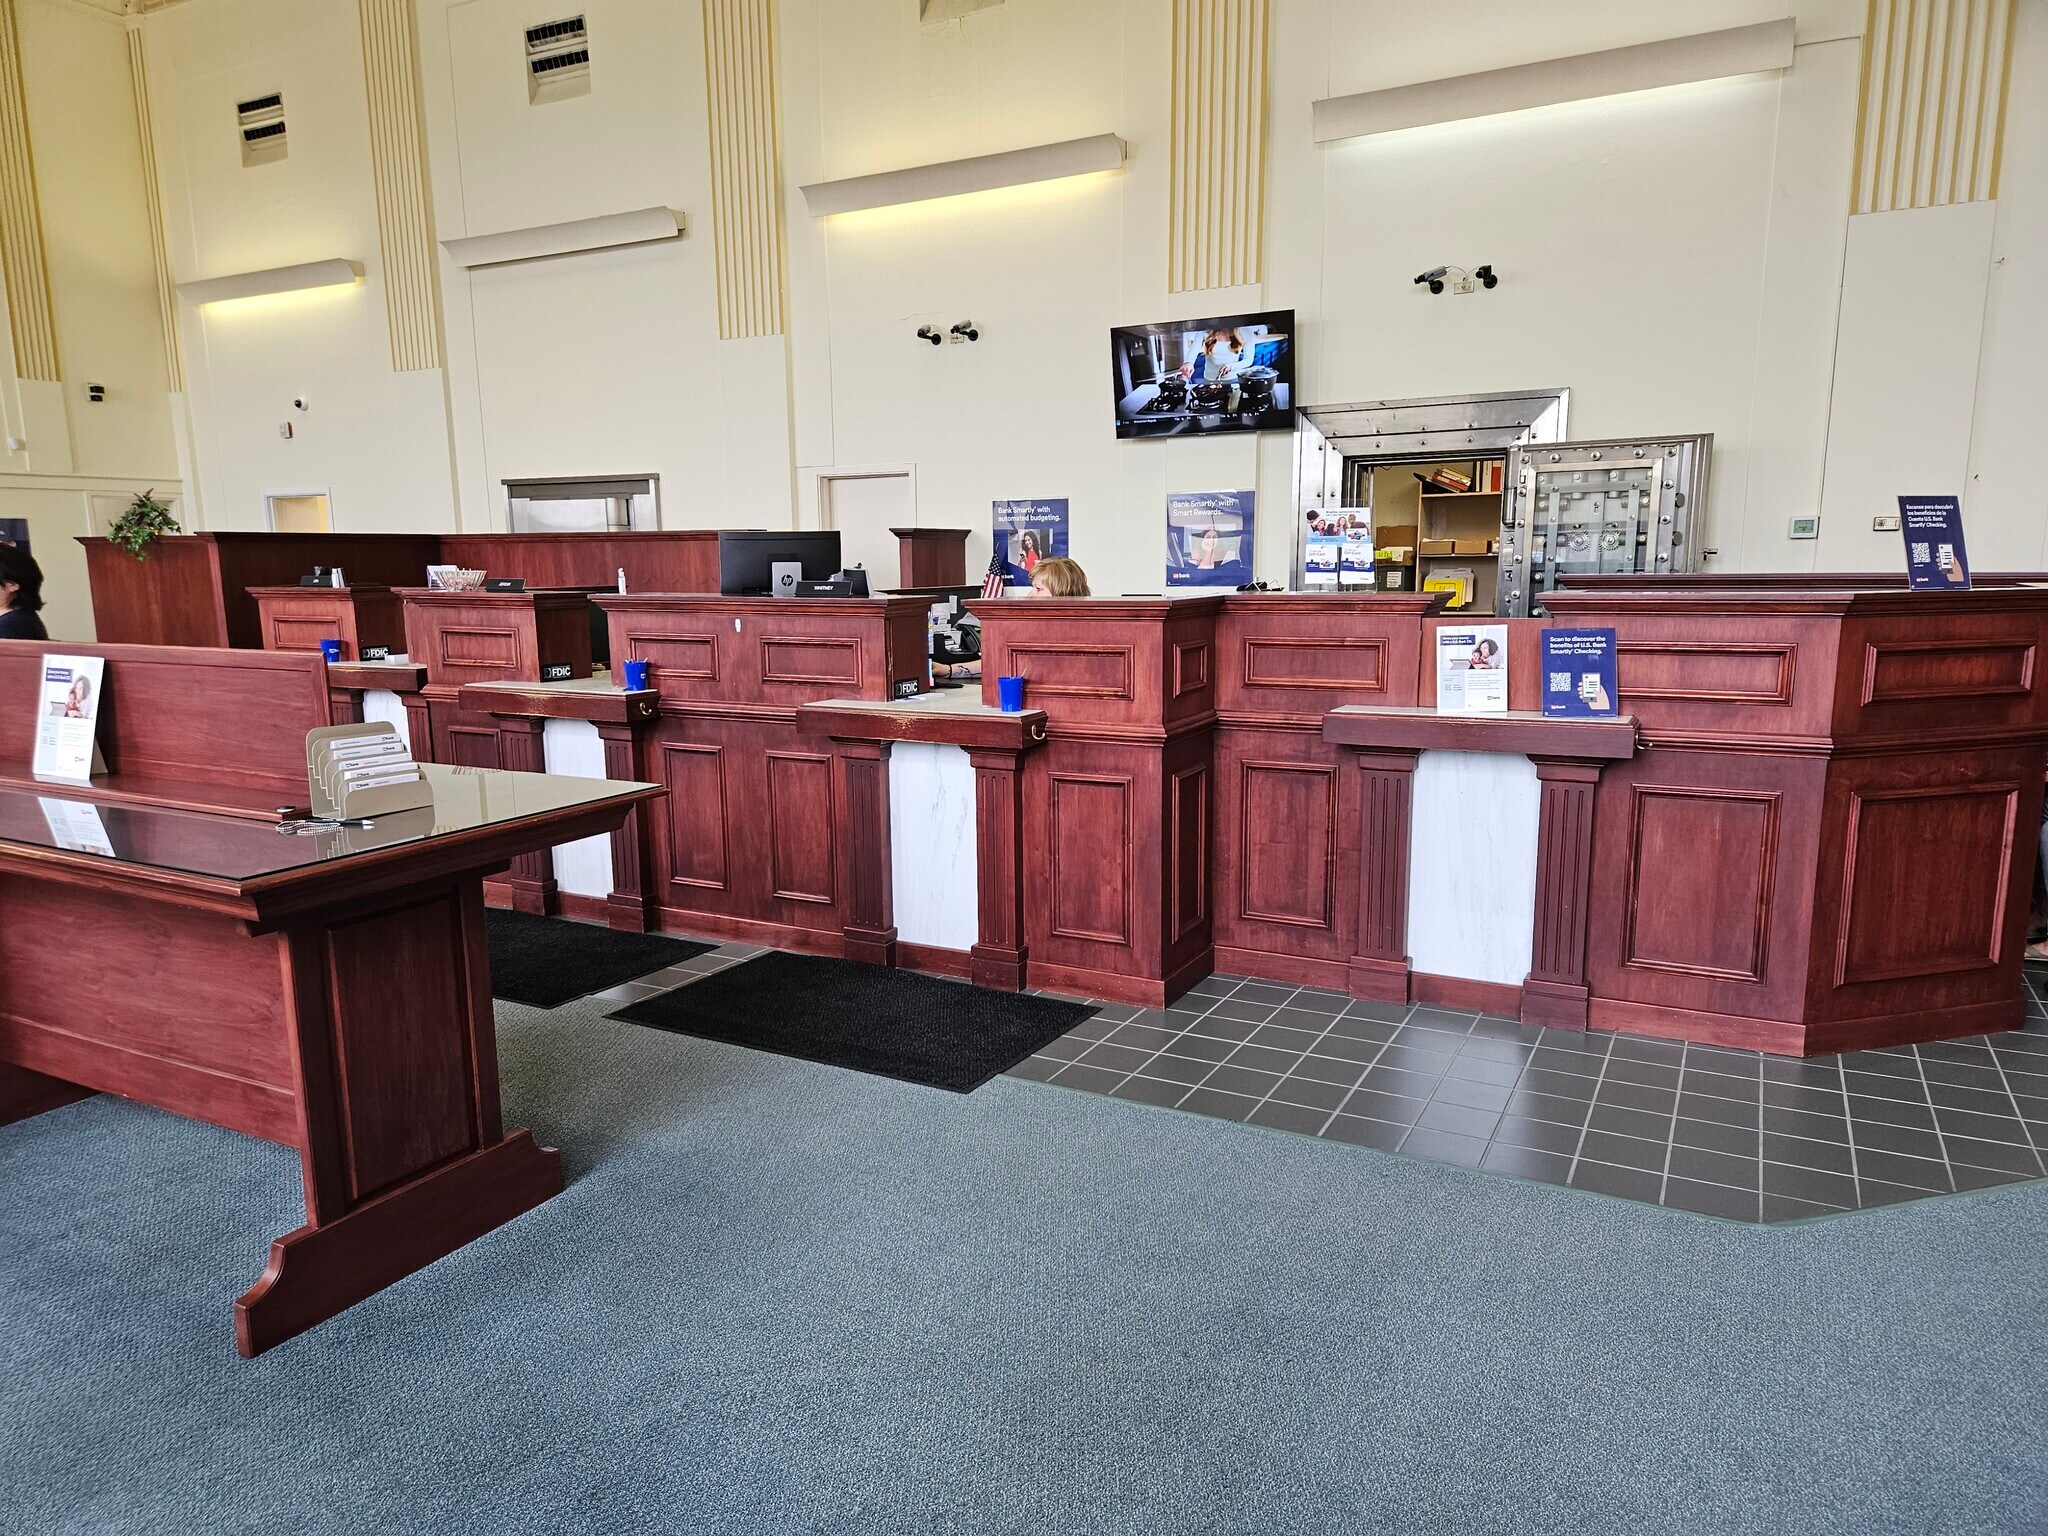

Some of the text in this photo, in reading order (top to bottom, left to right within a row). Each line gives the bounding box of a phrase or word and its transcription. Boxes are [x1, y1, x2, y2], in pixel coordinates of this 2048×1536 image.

[1030, 514, 1061, 522] budgeting.
[370, 647, 388, 657] FDIC
[552, 667, 571, 677] FDIC
[902, 682, 918, 694] FDIC
